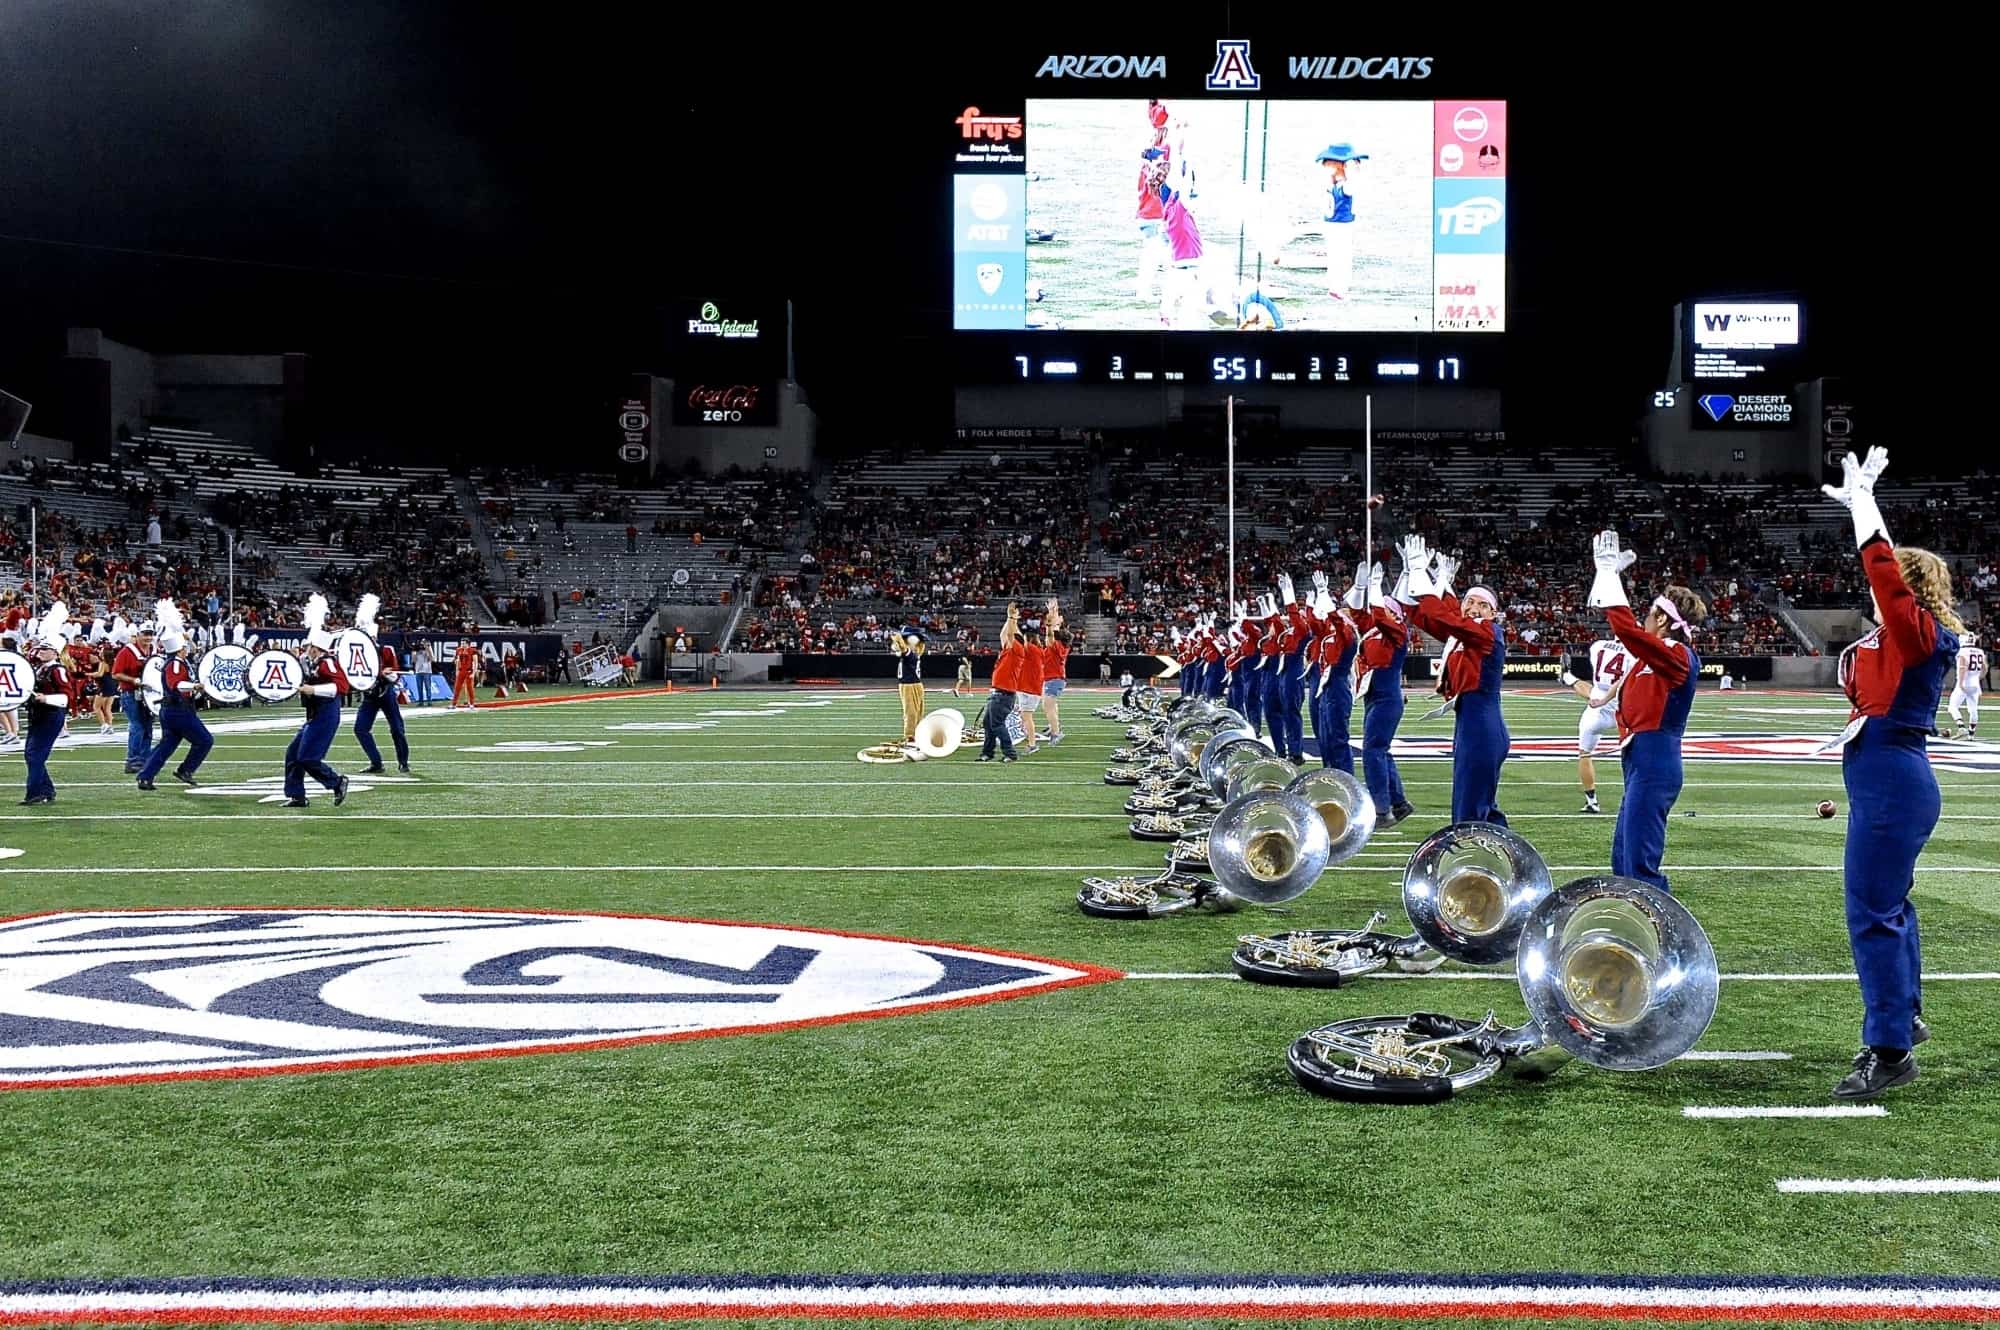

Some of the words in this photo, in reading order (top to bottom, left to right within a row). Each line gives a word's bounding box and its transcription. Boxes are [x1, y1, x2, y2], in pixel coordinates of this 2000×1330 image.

[1036, 55, 1167, 79] ARIZONA
[1206, 40, 1260, 90] A
[1288, 56, 1434, 79] WILDCATS
[1438, 197, 1503, 234] TEP
[1015, 356, 1029, 378] 7
[1112, 356, 1122, 370] 3
[1311, 356, 1320, 371] 3
[1337, 356, 1347, 371] 3
[1438, 358, 1460, 380] 17
[1654, 391, 1675, 407] 25
[1738, 395, 1787, 404] DESERT
[703, 410, 743, 422] zero
[1733, 404, 1792, 413] DIAMOND
[1734, 413, 1791, 422] CASINOS
[765, 448, 777, 458] 10
[347, 643, 373, 676] A
[428, 641, 526, 663] NISAN
[1502, 663, 1562, 675] gewest.org
[1595, 649, 1626, 685] 14
[258, 660, 293, 690] A
